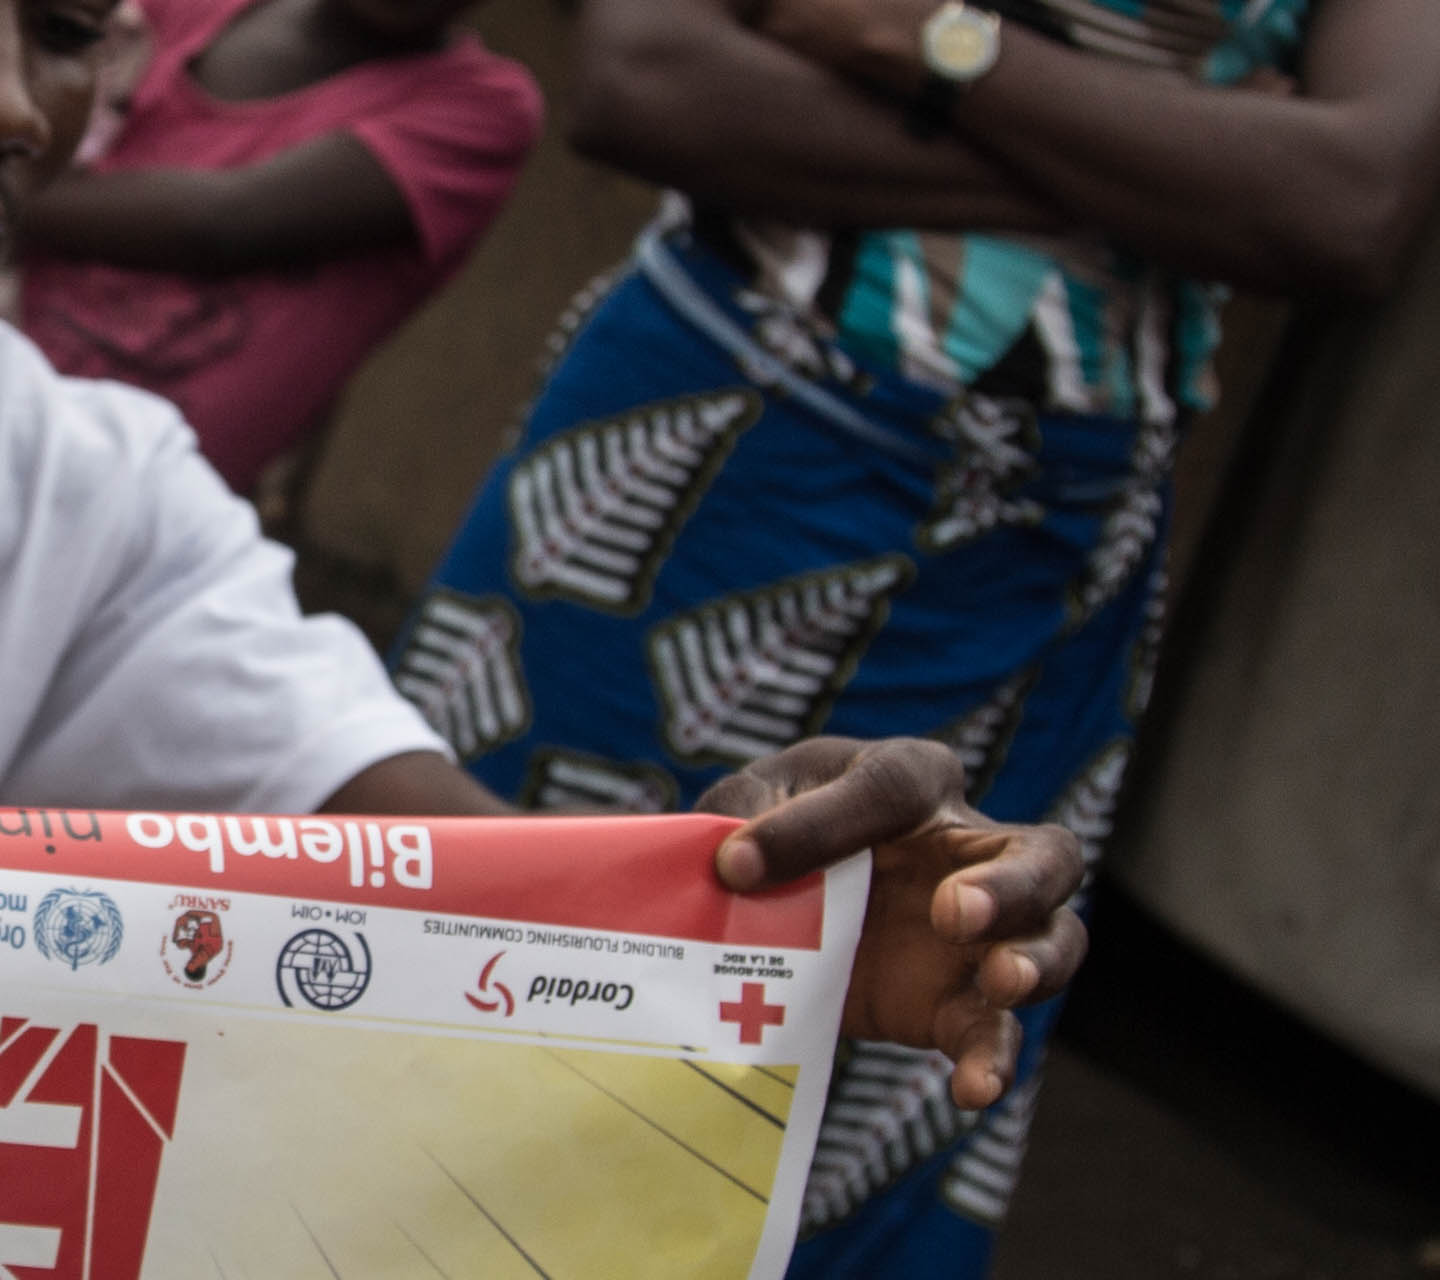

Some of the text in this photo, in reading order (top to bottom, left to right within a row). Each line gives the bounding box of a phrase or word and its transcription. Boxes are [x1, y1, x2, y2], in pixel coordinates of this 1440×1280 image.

[125, 813, 434, 890] Bilembo
[174, 894, 232, 912] SANRU
[291, 905, 367, 926] IOM OIM
[422, 919, 684, 961] BUILDING FLOURISHING COMMUNITIES
[722, 952, 785, 967] DE LA RDC
[713, 963, 794, 980] CROIX-ROUGE
[527, 975, 634, 1011] Cordaid
